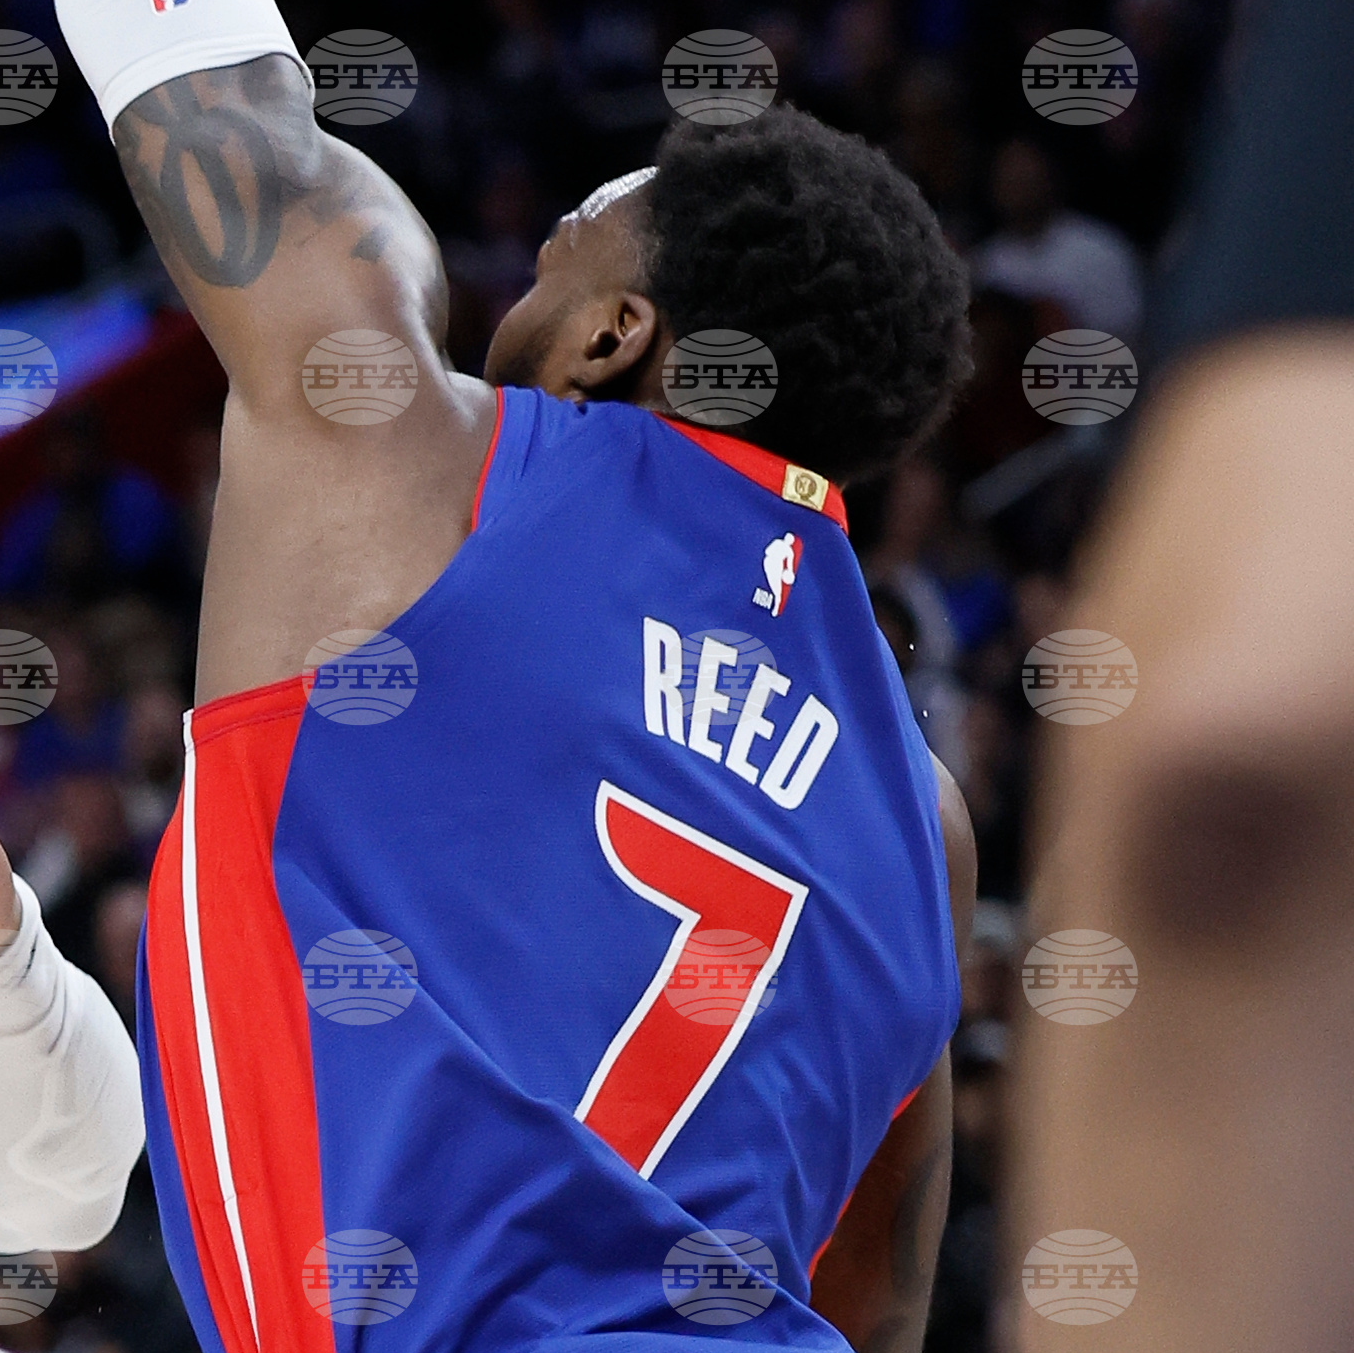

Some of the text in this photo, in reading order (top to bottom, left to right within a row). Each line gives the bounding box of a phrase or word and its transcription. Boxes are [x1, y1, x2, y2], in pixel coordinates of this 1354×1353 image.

[752, 587, 774, 611] NBA
[642, 616, 840, 811] REED
[573, 779, 809, 1181] 7
